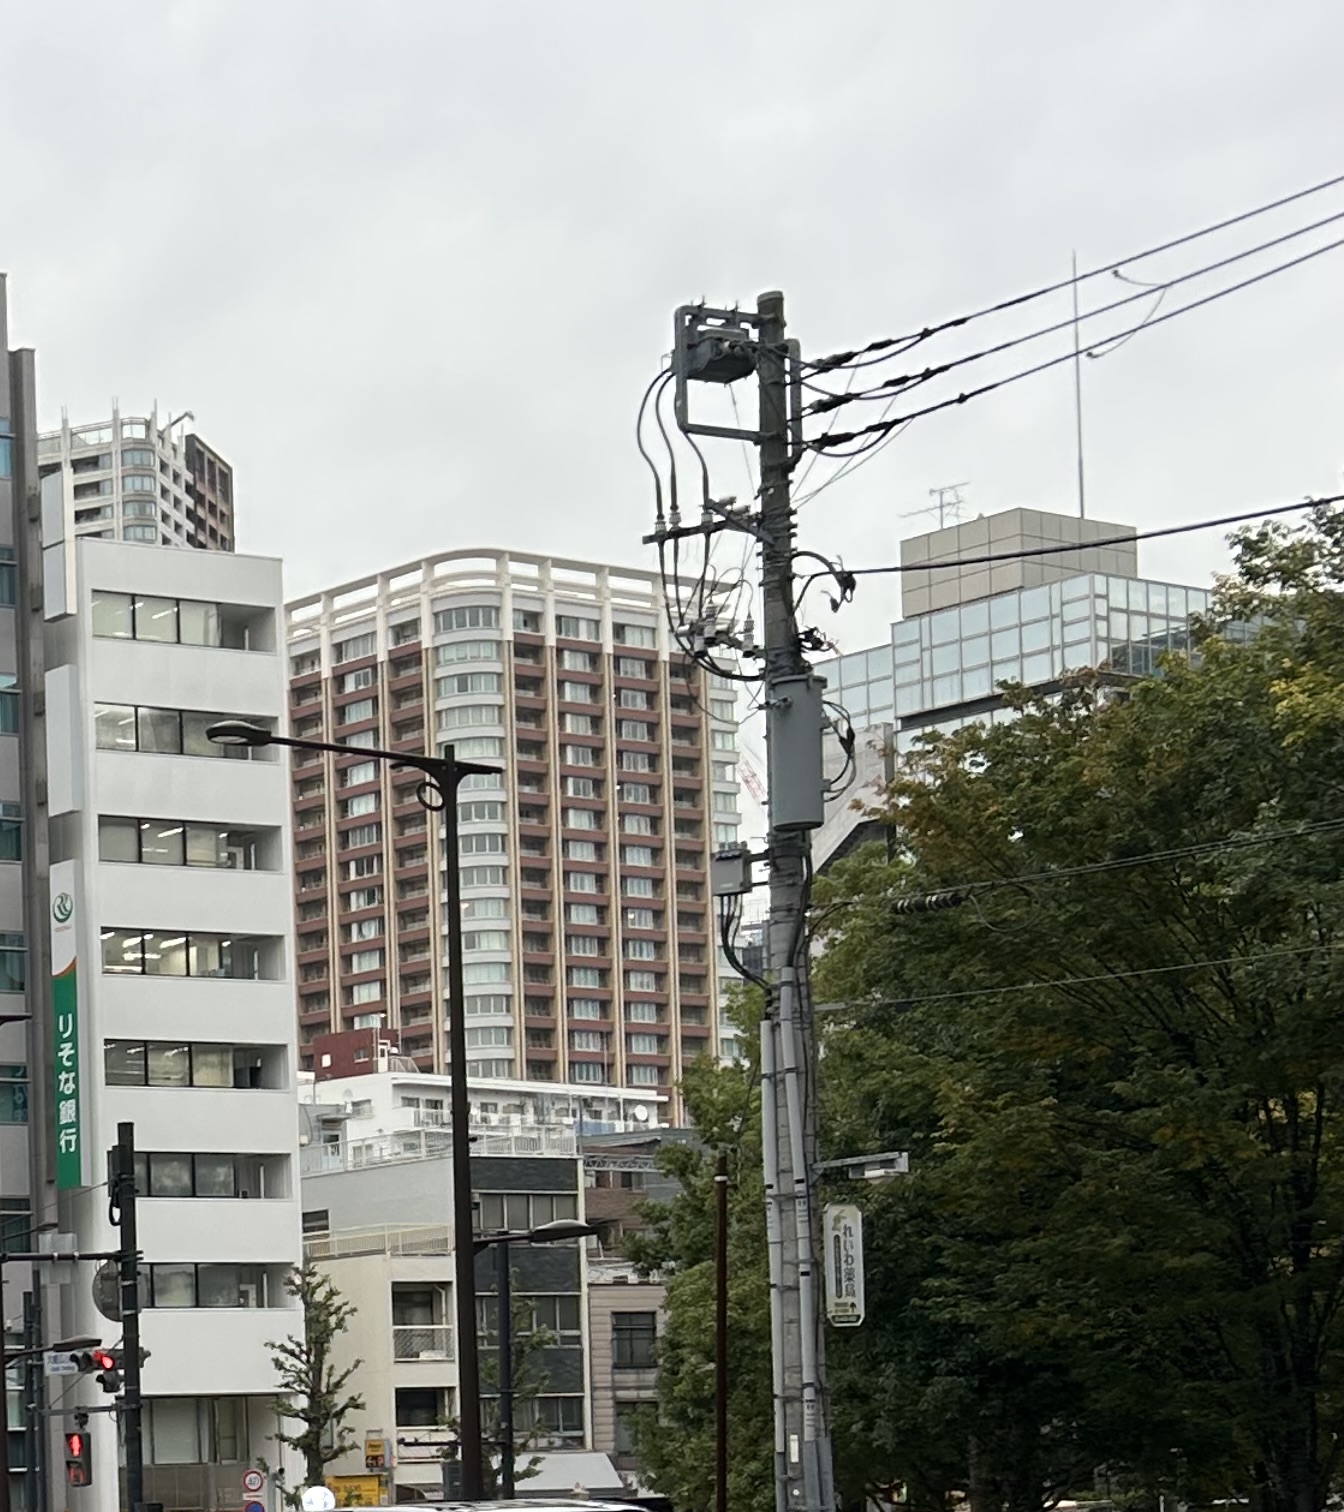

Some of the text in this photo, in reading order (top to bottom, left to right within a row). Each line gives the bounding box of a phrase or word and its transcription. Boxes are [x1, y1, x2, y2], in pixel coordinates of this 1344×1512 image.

[57, 1013, 78, 1153] りそな銀行
[843, 1224, 856, 1298] れいわ薬局
